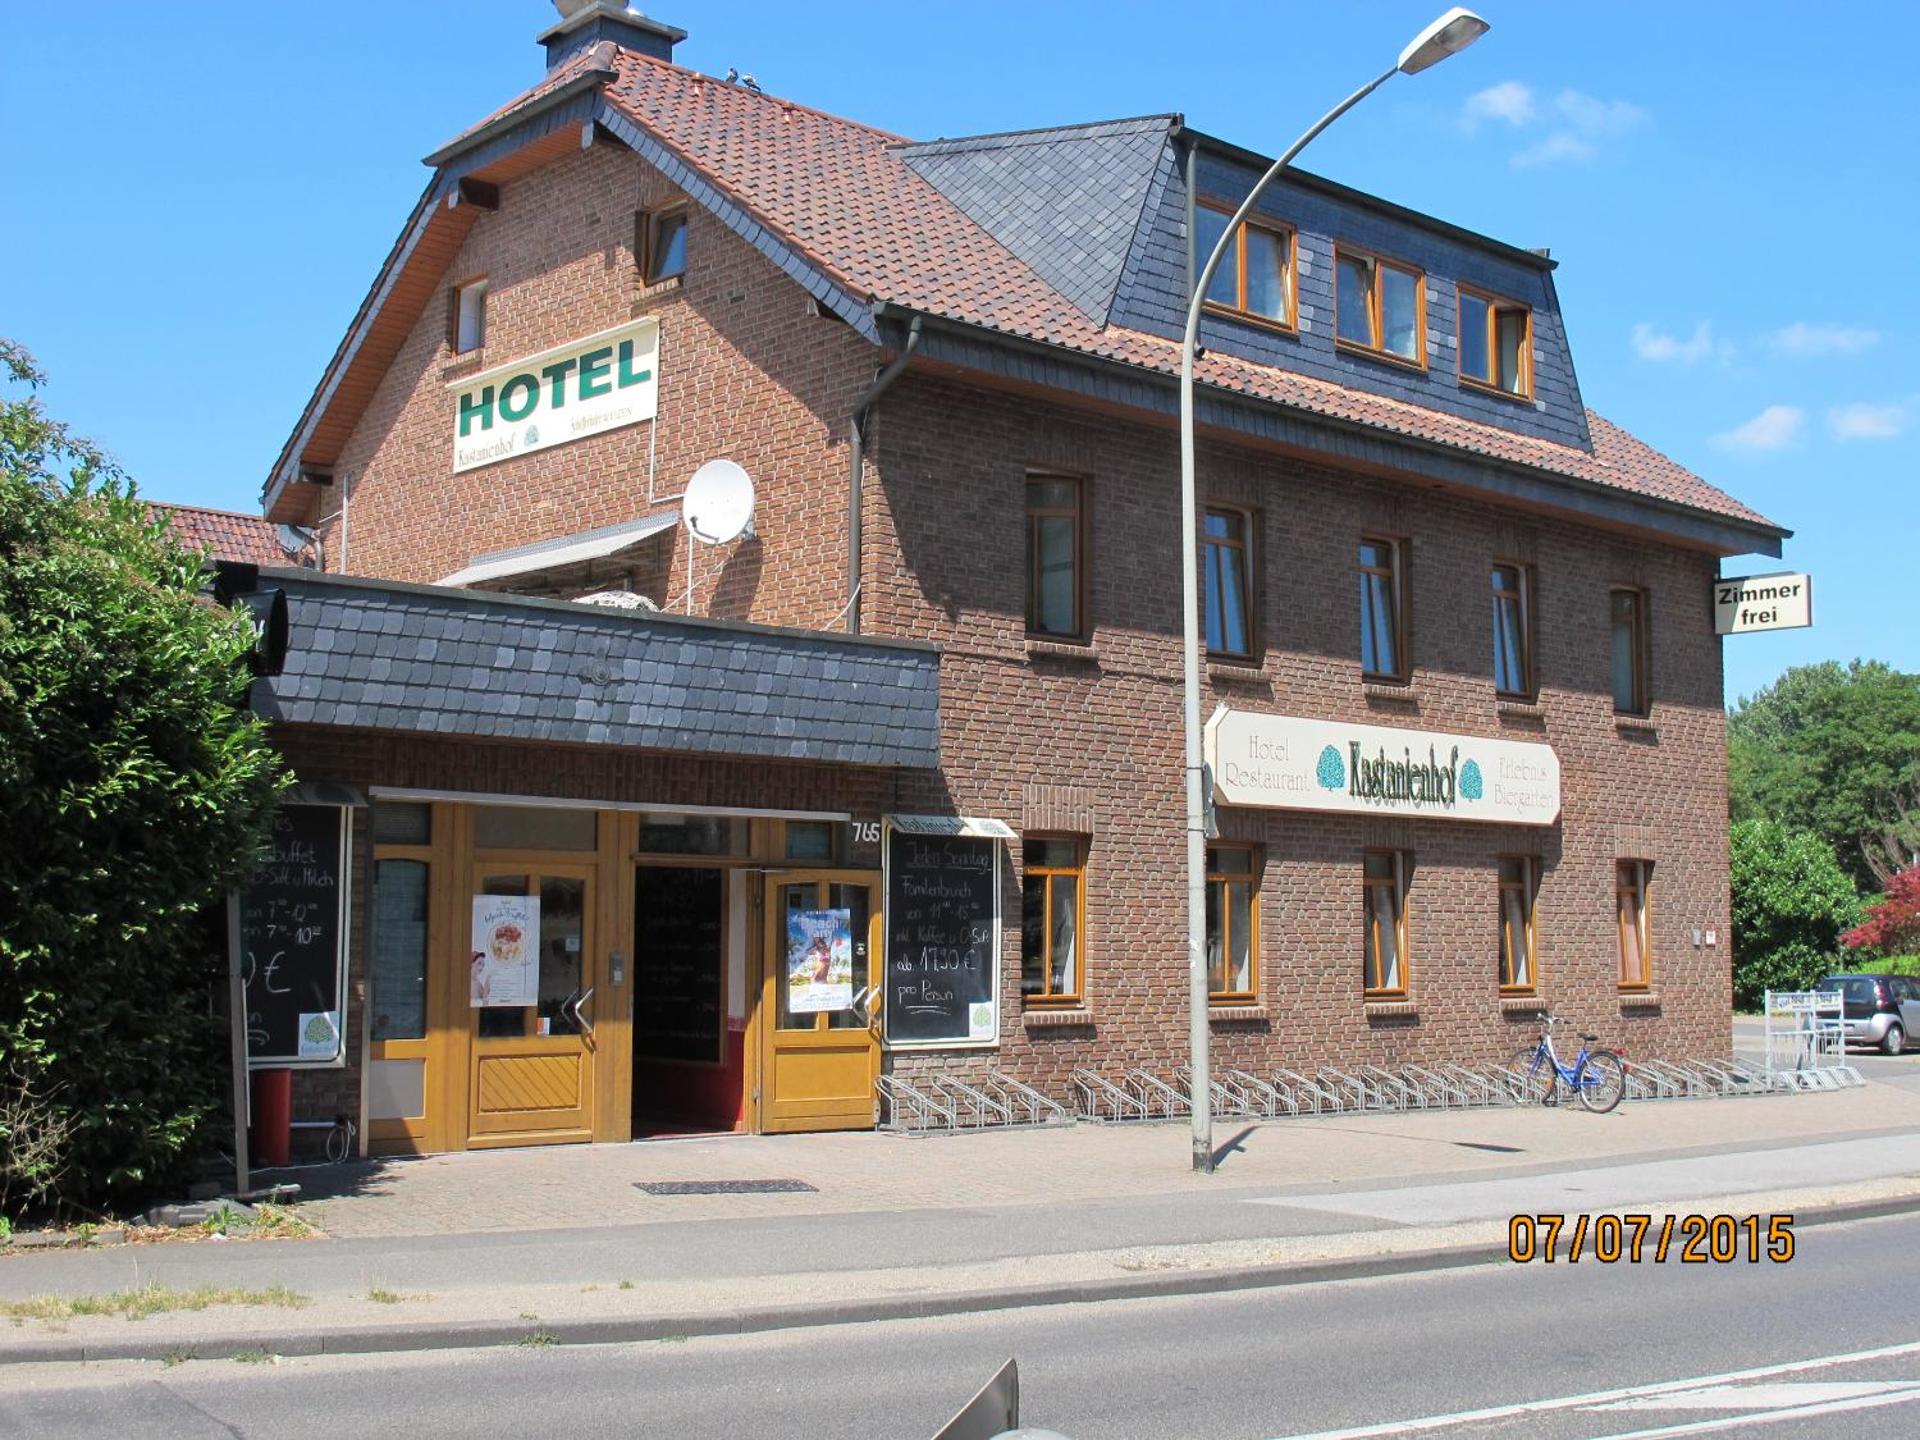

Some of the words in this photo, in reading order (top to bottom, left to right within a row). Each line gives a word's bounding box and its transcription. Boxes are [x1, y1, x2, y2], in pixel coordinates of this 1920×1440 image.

[459, 339, 651, 438] HOTEL
[1719, 584, 1801, 605] Zimmer
[1741, 607, 1778, 625] frei
[1249, 735, 1289, 761] Hotel
[1225, 763, 1311, 792] Restaurant
[1348, 741, 1459, 805] Kastanienhof
[1494, 785, 1554, 814] Biergarten
[852, 822, 881, 842] 765
